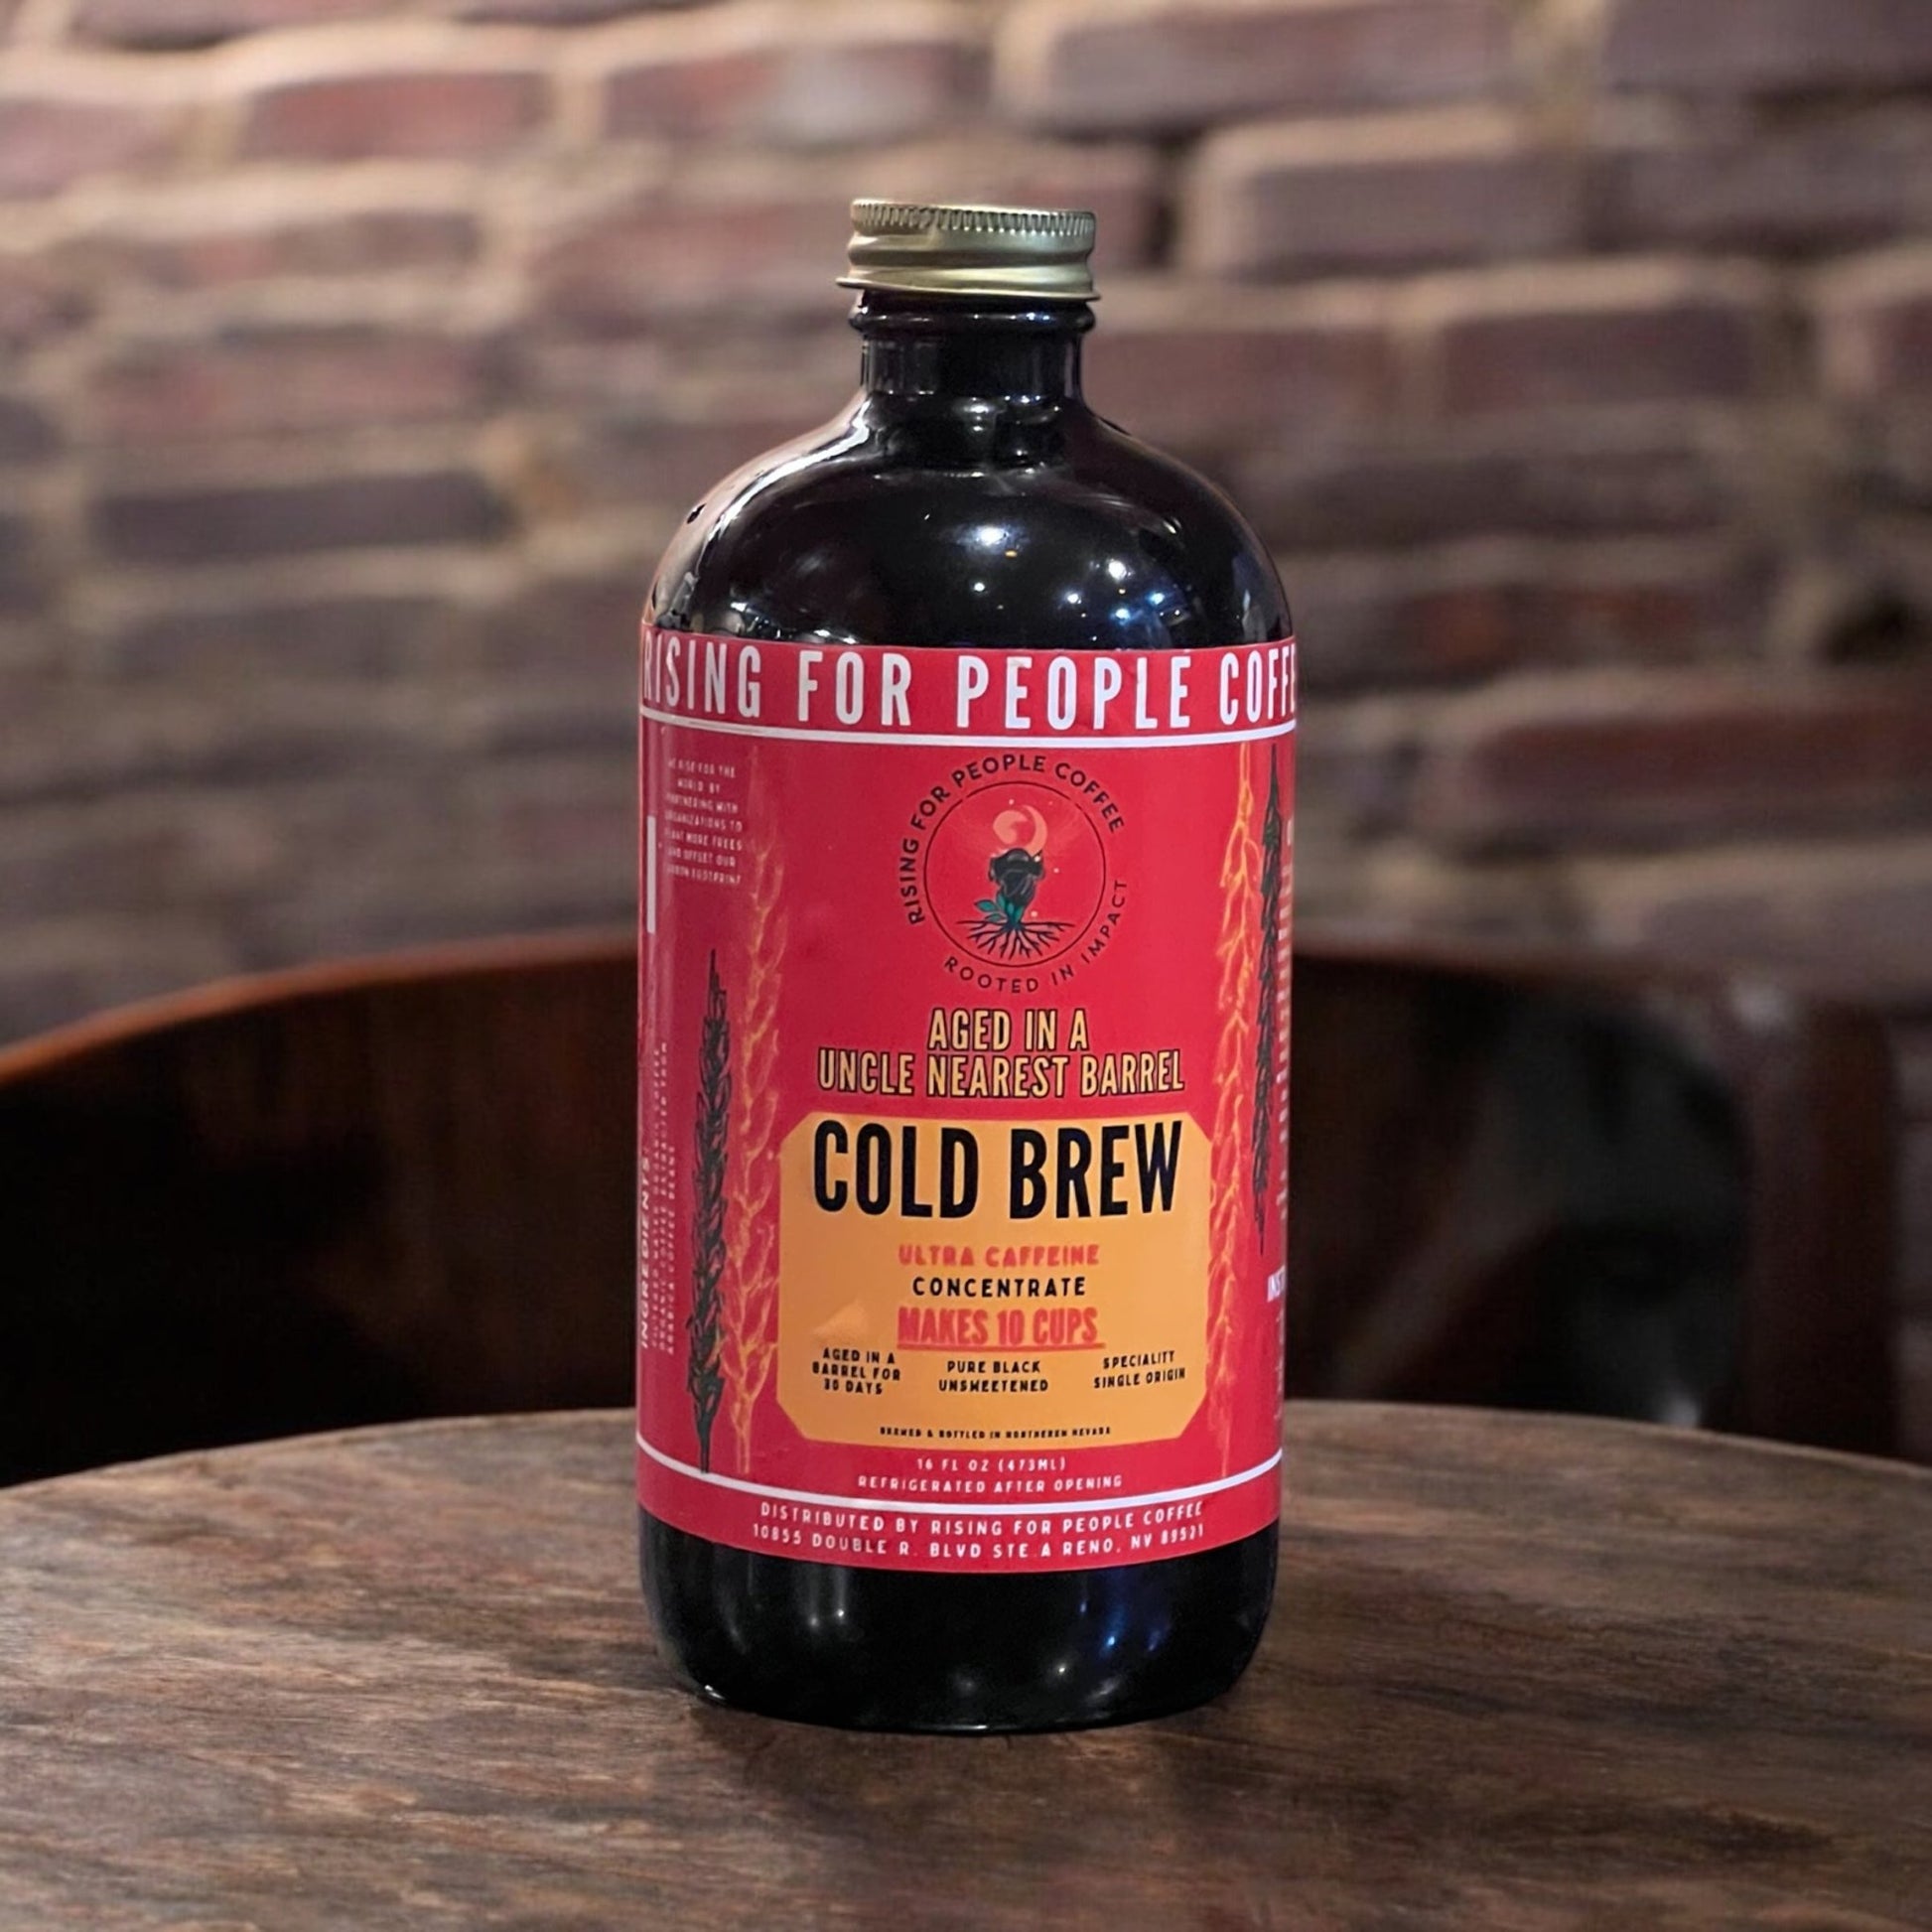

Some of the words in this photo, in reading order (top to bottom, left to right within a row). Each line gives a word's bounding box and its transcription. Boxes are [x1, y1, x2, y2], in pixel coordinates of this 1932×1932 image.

[643, 629, 761, 718] RISING
[796, 649, 911, 726] FOR
[956, 653, 1191, 731] PEOPLE
[951, 755, 1046, 788] PEOPLE
[910, 785, 950, 830] FOR
[1055, 762, 1125, 834] COFFEE
[899, 838, 925, 924] RISING
[944, 955, 1039, 993] ROOTED
[1050, 964, 1074, 986] IN
[1081, 880, 1128, 964] IMPACT
[927, 1009, 1011, 1050] AGED
[1025, 1009, 1056, 1050] IN
[1068, 1009, 1090, 1050] A
[817, 1047, 915, 1096] UNCLE
[926, 1054, 1069, 1098] NEAREST
[1080, 1048, 1185, 1098] BARREL
[813, 1119, 979, 1219] COLD
[1009, 1119, 1182, 1220] BREW
[898, 1244, 975, 1267] ULTRA
[985, 1243, 1101, 1268] CAFFEINE
[912, 1275, 1086, 1298] CONCENTRATE
[897, 1306, 989, 1345] MAKES
[997, 1308, 1026, 1346] 10
[1033, 1306, 1098, 1345] CUPS
[823, 1347, 861, 1362] AGED
[866, 1351, 881, 1364] IN
[887, 1352, 896, 1365] A
[947, 1360, 987, 1373] PURE
[993, 1360, 1040, 1374] BLACK
[1103, 1350, 1174, 1370] SPECIALITY
[812, 1361, 866, 1379] BARREL
[873, 1367, 901, 1381] FOR
[1093, 1372, 1141, 1389] SINGLE
[1146, 1367, 1185, 1384] ORIGIN
[846, 1381, 884, 1395] DAYS
[938, 1379, 1048, 1392] UNSWEETENED
[938, 1430, 986, 1440] BOTTLED
[917, 1457, 933, 1470] 16
[942, 1458, 958, 1472] FL
[968, 1458, 990, 1472] OZ
[998, 1456, 1065, 1472] (473ML)
[858, 1474, 986, 1493] REFRIGERATED
[994, 1480, 1045, 1493] AFTER
[1053, 1474, 1123, 1492] OPENING
[760, 1501, 885, 1532] DISTRIBUTED
[896, 1517, 918, 1534] BY
[931, 1519, 1003, 1536] RISING
[1014, 1519, 1051, 1535] FOR
[1062, 1512, 1135, 1534] PEOPLE
[1143, 1500, 1203, 1526] COFFEE
[812, 1533, 888, 1555] DOUBLE
[929, 1541, 982, 1558] BLVD
[1040, 1541, 1052, 1557] A
[1131, 1533, 1153, 1550] NV
